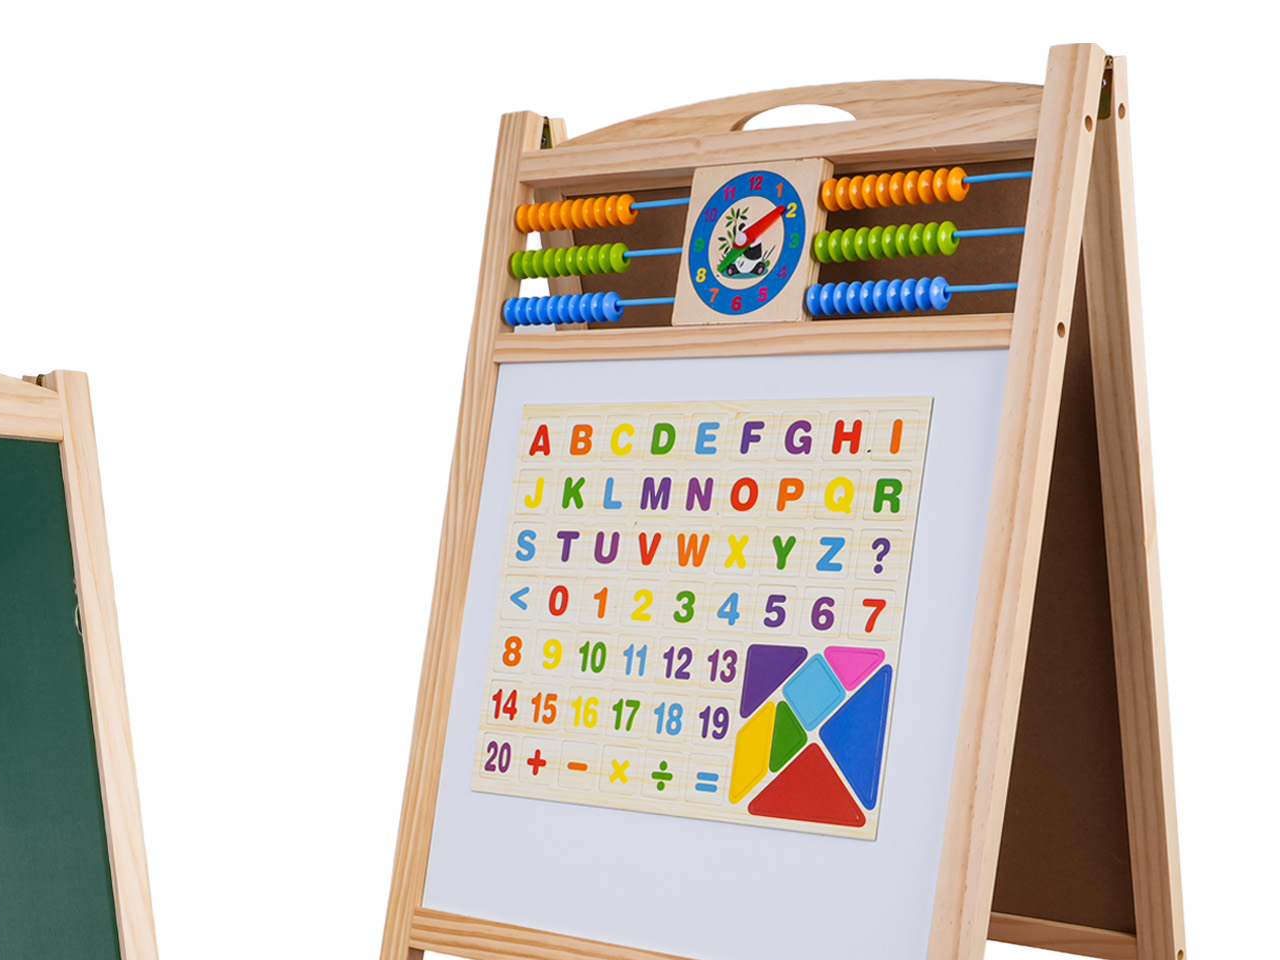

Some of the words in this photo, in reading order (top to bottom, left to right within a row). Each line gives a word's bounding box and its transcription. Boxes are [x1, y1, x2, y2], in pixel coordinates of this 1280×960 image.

[749, 175, 763, 190] 12
[724, 186, 736, 200] 11
[776, 183, 783, 197] 1
[704, 208, 717, 222] 10
[786, 203, 797, 218] 2
[694, 238, 704, 252] 9
[789, 234, 800, 248] 3
[696, 268, 706, 282] 8
[777, 265, 787, 279] 4
[710, 288, 719, 302] 7
[758, 287, 768, 301] 5
[731, 296, 742, 310] 6
[529, 425, 551, 456] A
[570, 425, 592, 456] B
[609, 423, 635, 456] C
[650, 423, 676, 454] D
[695, 422, 720, 454] E
[740, 421, 765, 454] F
[784, 420, 812, 454] G
[832, 420, 861, 454] H
[889, 419, 903, 454] I
[524, 477, 545, 508] J
[562, 477, 585, 509] K
[603, 477, 622, 510] L
[640, 478, 671, 510] M
[685, 477, 713, 510] N
[730, 477, 758, 510] O
[777, 478, 804, 510] P
[824, 477, 855, 513] Q
[873, 479, 903, 513] R
[516, 530, 536, 561] S
[557, 531, 579, 562] T
[594, 532, 620, 564] U
[638, 533, 661, 566] V
[677, 534, 710, 566] W
[724, 535, 748, 568] X
[772, 536, 796, 570] Y
[816, 537, 845, 571] Z
[871, 538, 890, 573] ?
[548, 586, 569, 616] 0
[594, 588, 608, 618] 1
[631, 589, 653, 620] 2
[674, 591, 695, 622] 3
[717, 593, 740, 625] 4
[763, 594, 786, 627] 5
[811, 597, 834, 630] 6
[862, 599, 886, 632] 7
[502, 637, 522, 666] 8
[542, 639, 562, 669] 9
[579, 642, 607, 672] 10
[623, 644, 648, 676] 11
[663, 647, 693, 680] 12
[708, 649, 738, 682] 13
[492, 690, 518, 720] 14
[531, 693, 557, 724] 15
[571, 696, 598, 727] 16
[612, 700, 641, 731] 17
[654, 703, 682, 734] 18
[699, 706, 729, 739] 19
[484, 742, 511, 773] 20
